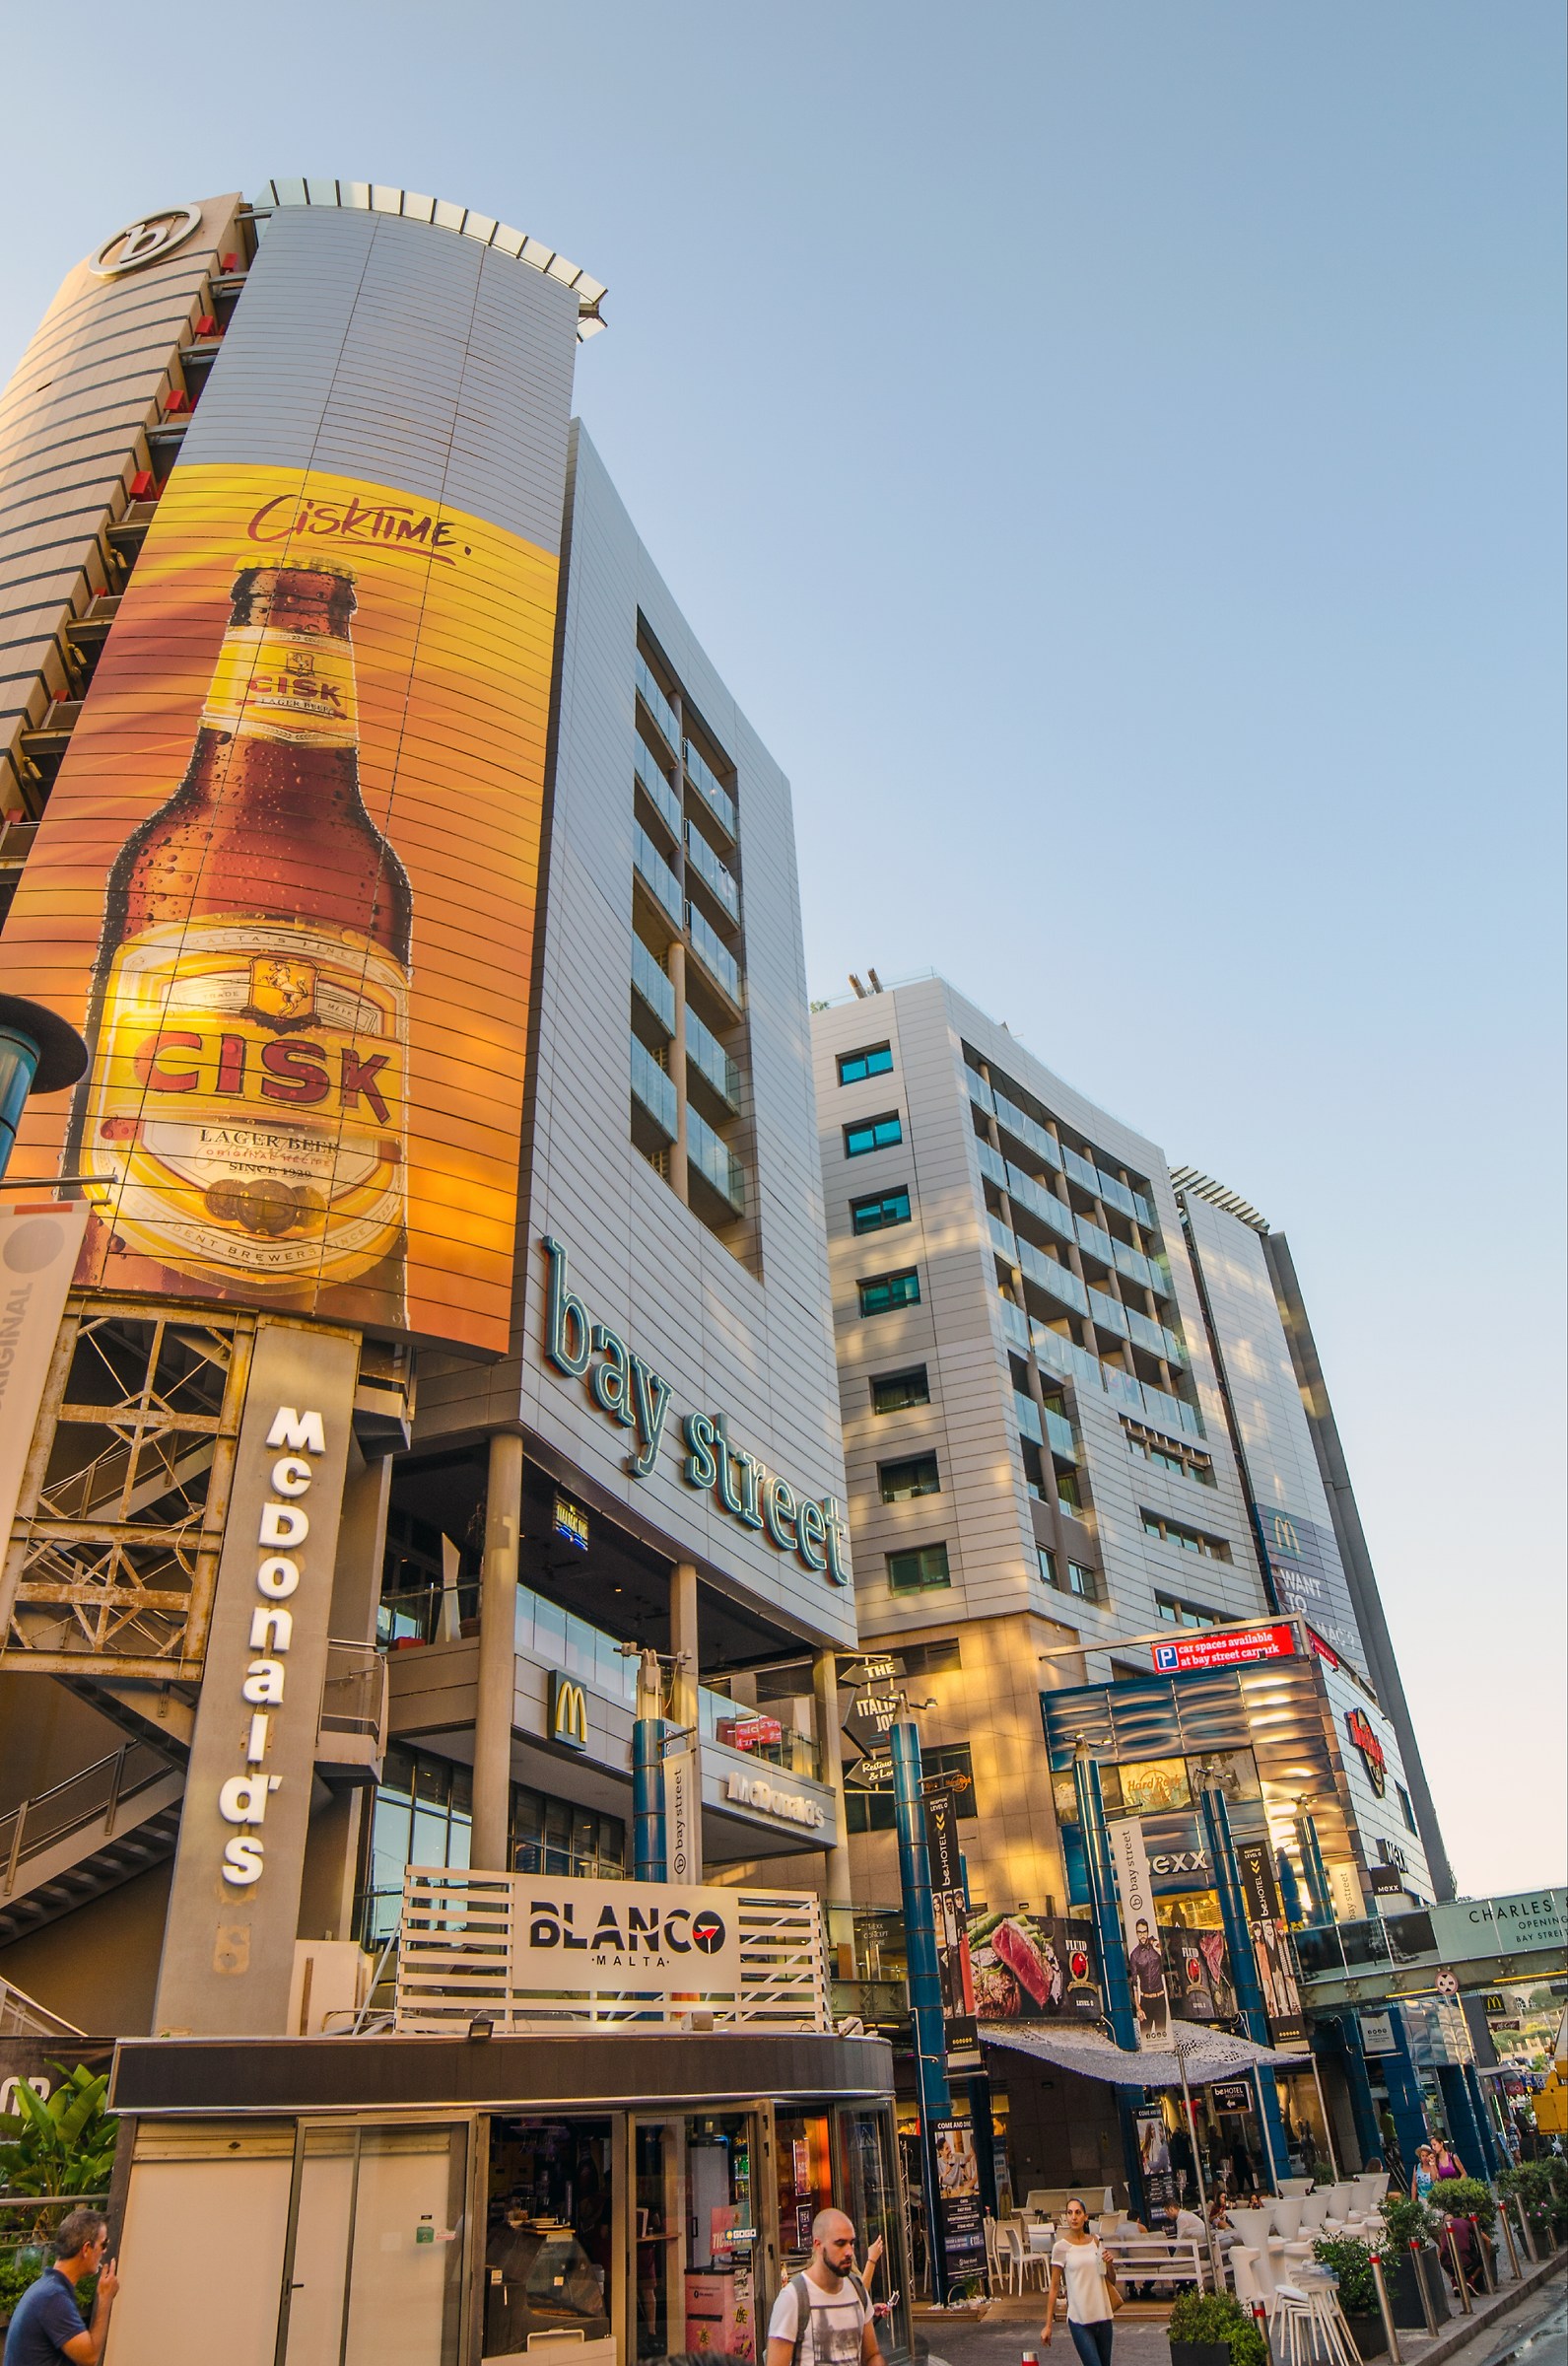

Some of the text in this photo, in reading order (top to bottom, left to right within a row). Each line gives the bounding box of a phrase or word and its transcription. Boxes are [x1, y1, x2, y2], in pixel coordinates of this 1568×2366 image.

[246, 675, 342, 707] CISK
[260, 696, 301, 708] LAGER
[203, 990, 239, 1000] TRADE
[133, 1031, 391, 1126] CISK
[200, 1129, 339, 1154] LAGER BEER
[206, 1148, 277, 1161] ORIGINAL
[229, 1161, 277, 1175] SINCE
[228, 1245, 317, 1262] BREWERS
[541, 1235, 850, 1587] bay street
[1280, 1568, 1322, 1597] WANT
[1285, 1591, 1308, 1614] TO
[219, 1407, 326, 1886] McDonald's
[1179, 1632, 1273, 1654] car spaces available
[1181, 1657, 1192, 1667] at
[1193, 1654, 1210, 1667] bay
[1211, 1650, 1240, 1663] street
[864, 1662, 896, 1678] THE
[1127, 1777, 1154, 1791] Hard
[675, 1820, 685, 1849] bay
[1123, 1830, 1134, 1866] street
[1129, 1870, 1139, 1892] bay
[1340, 1873, 1353, 1902] street
[1468, 1899, 1552, 1923] CHARLES
[529, 1901, 726, 1954] BLANCO
[1518, 1915, 1568, 1930] OPENING
[1064, 1939, 1088, 1952] FLUID
[1516, 1934, 1533, 1943] BAY
[1182, 1947, 1199, 1958] FLUID
